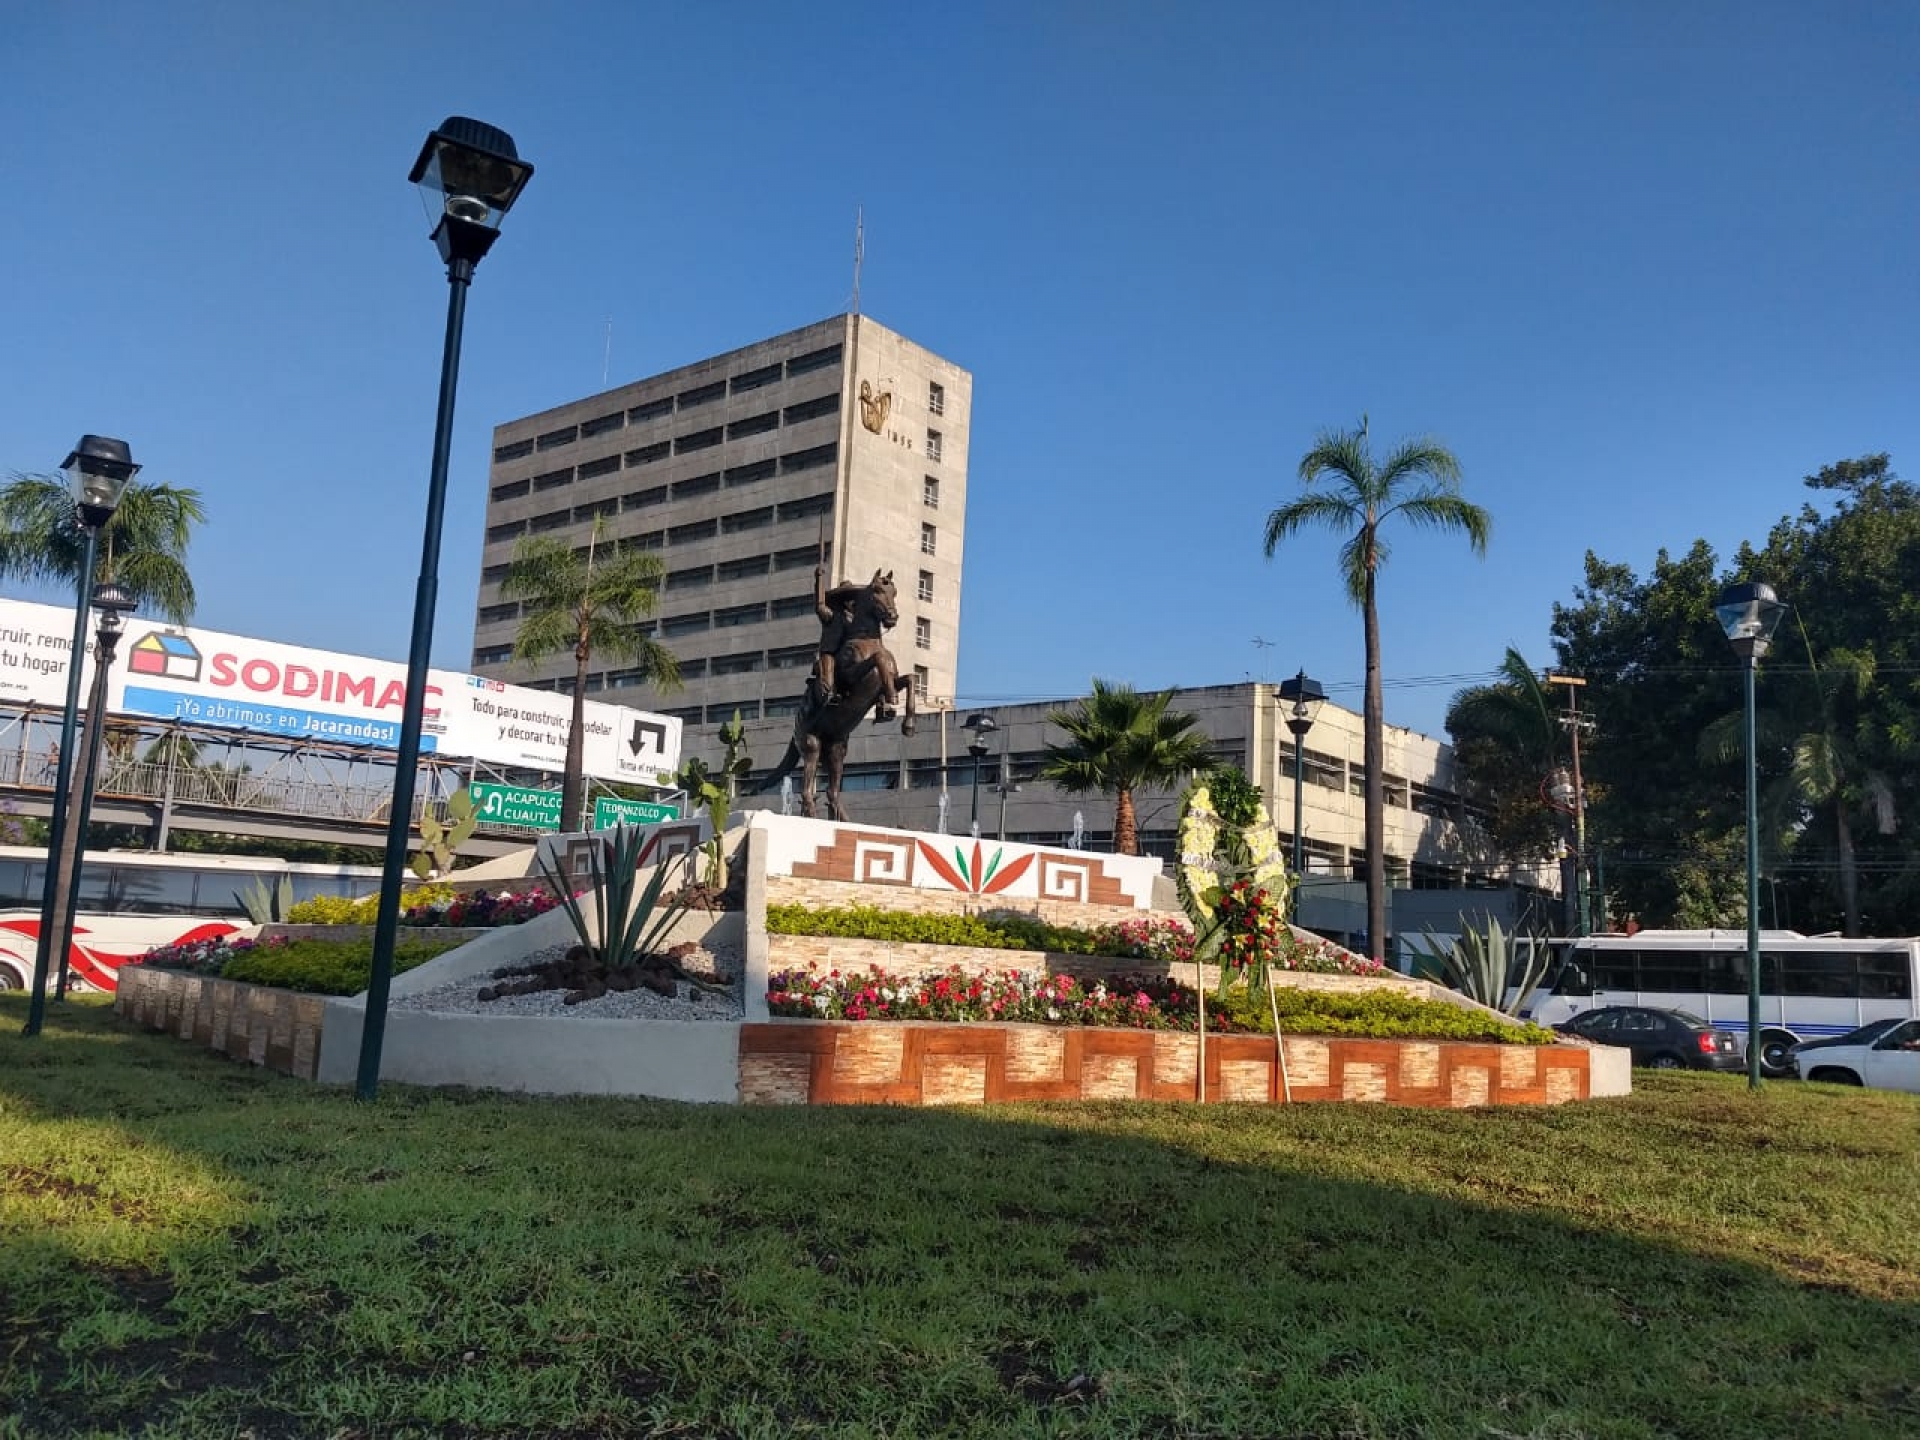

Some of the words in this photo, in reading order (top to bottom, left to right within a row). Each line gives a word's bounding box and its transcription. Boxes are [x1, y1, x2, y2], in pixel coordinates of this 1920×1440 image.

[0, 627, 31, 647] ruir,
[2, 649, 17, 667] tu
[23, 652, 66, 675] hogar
[210, 653, 443, 716] SODIMAC
[206, 703, 273, 724] abrimos
[279, 714, 297, 728] en
[302, 714, 394, 741] Jacarandas!
[472, 697, 495, 715] Todo
[497, 706, 519, 719] para
[567, 718, 613, 736] rodelar
[498, 726, 506, 740] y
[508, 725, 543, 743] decorar
[547, 732, 557, 745] tu
[505, 792, 563, 809] ACAPULCO
[503, 808, 562, 824] CUAUTLA
